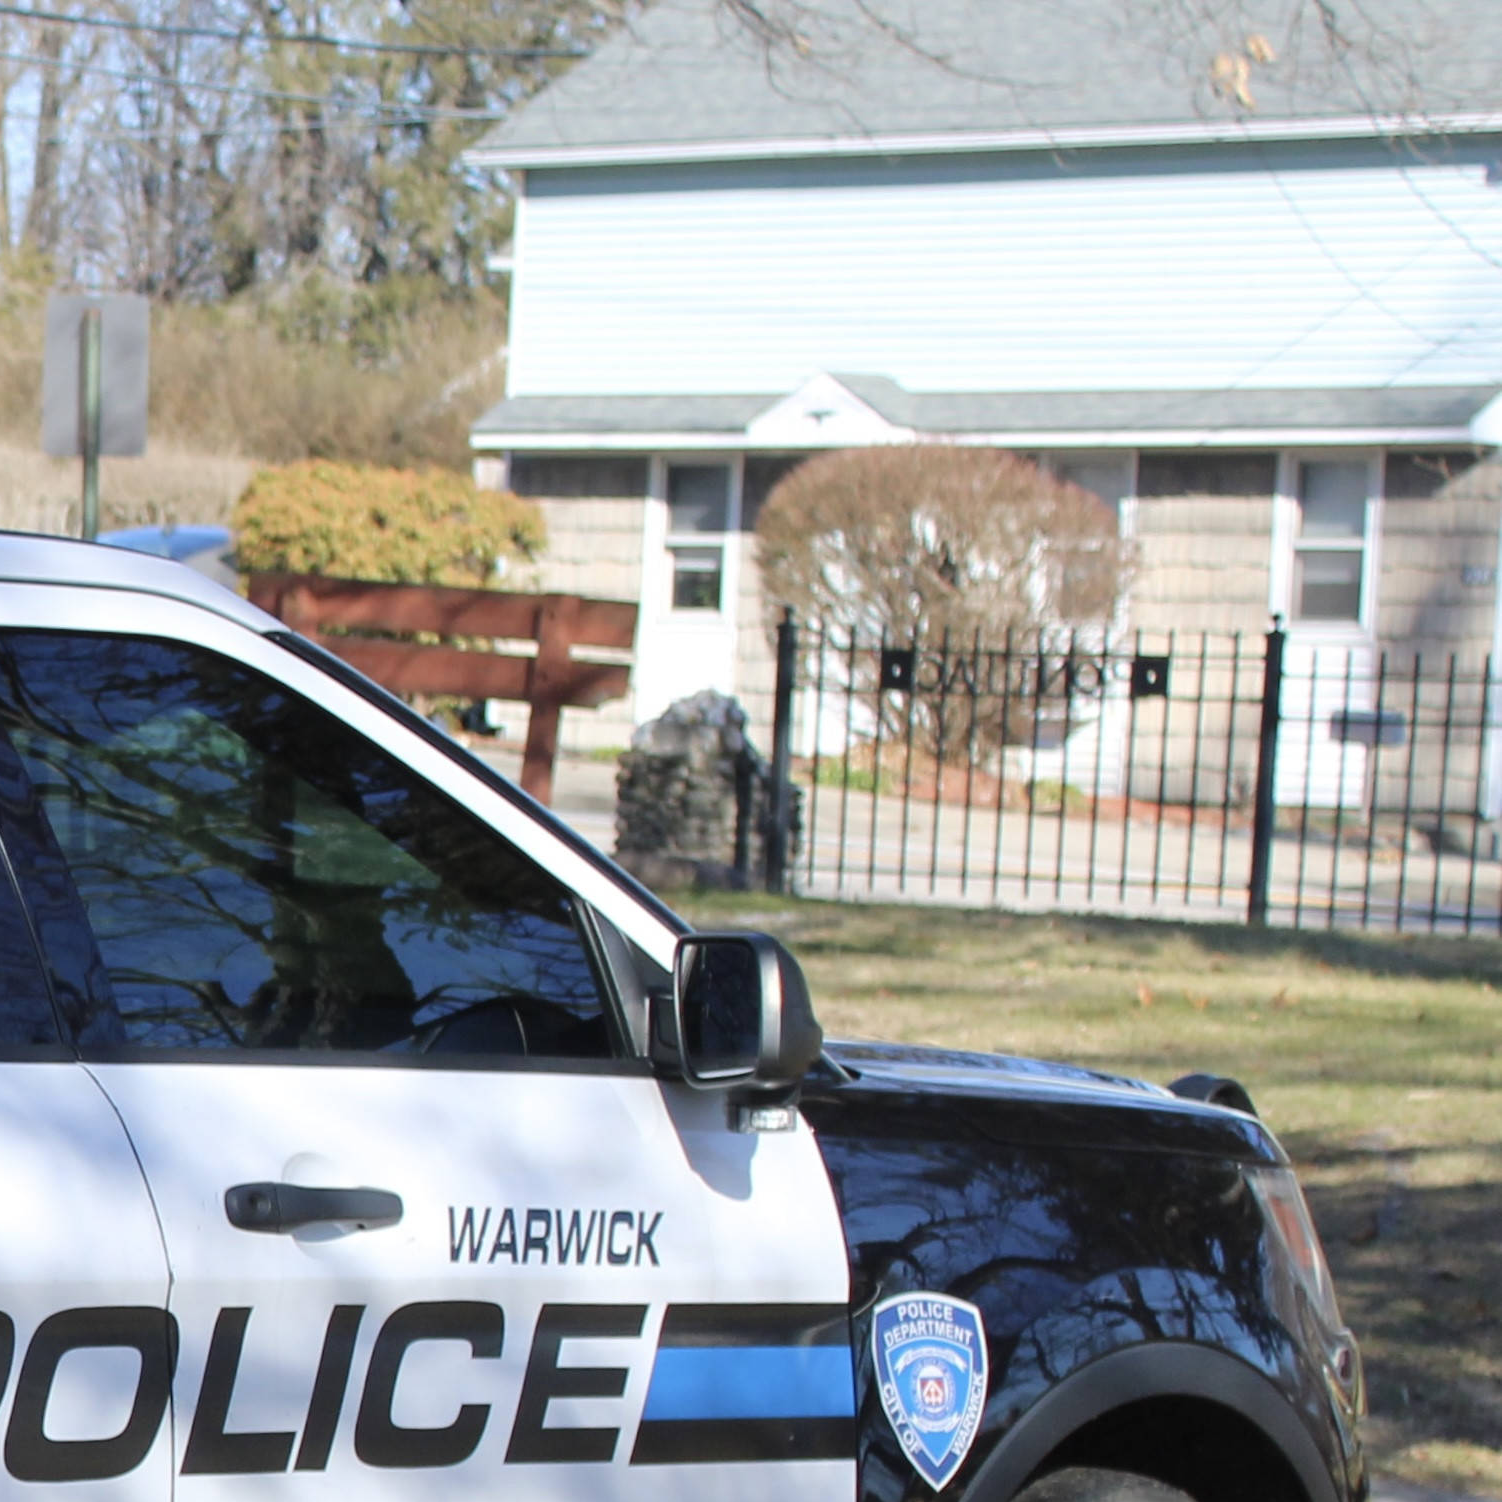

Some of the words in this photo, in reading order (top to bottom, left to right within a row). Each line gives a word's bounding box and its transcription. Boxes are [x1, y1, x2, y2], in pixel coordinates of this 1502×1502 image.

[448, 1206, 664, 1267] WARWICK
[883, 1320, 974, 1347] DEPARTMENT
[897, 1302, 954, 1321] POLICE
[882, 1383, 907, 1426] CITY
[902, 1430, 924, 1454] OF
[950, 1371, 984, 1457] WARWICK
